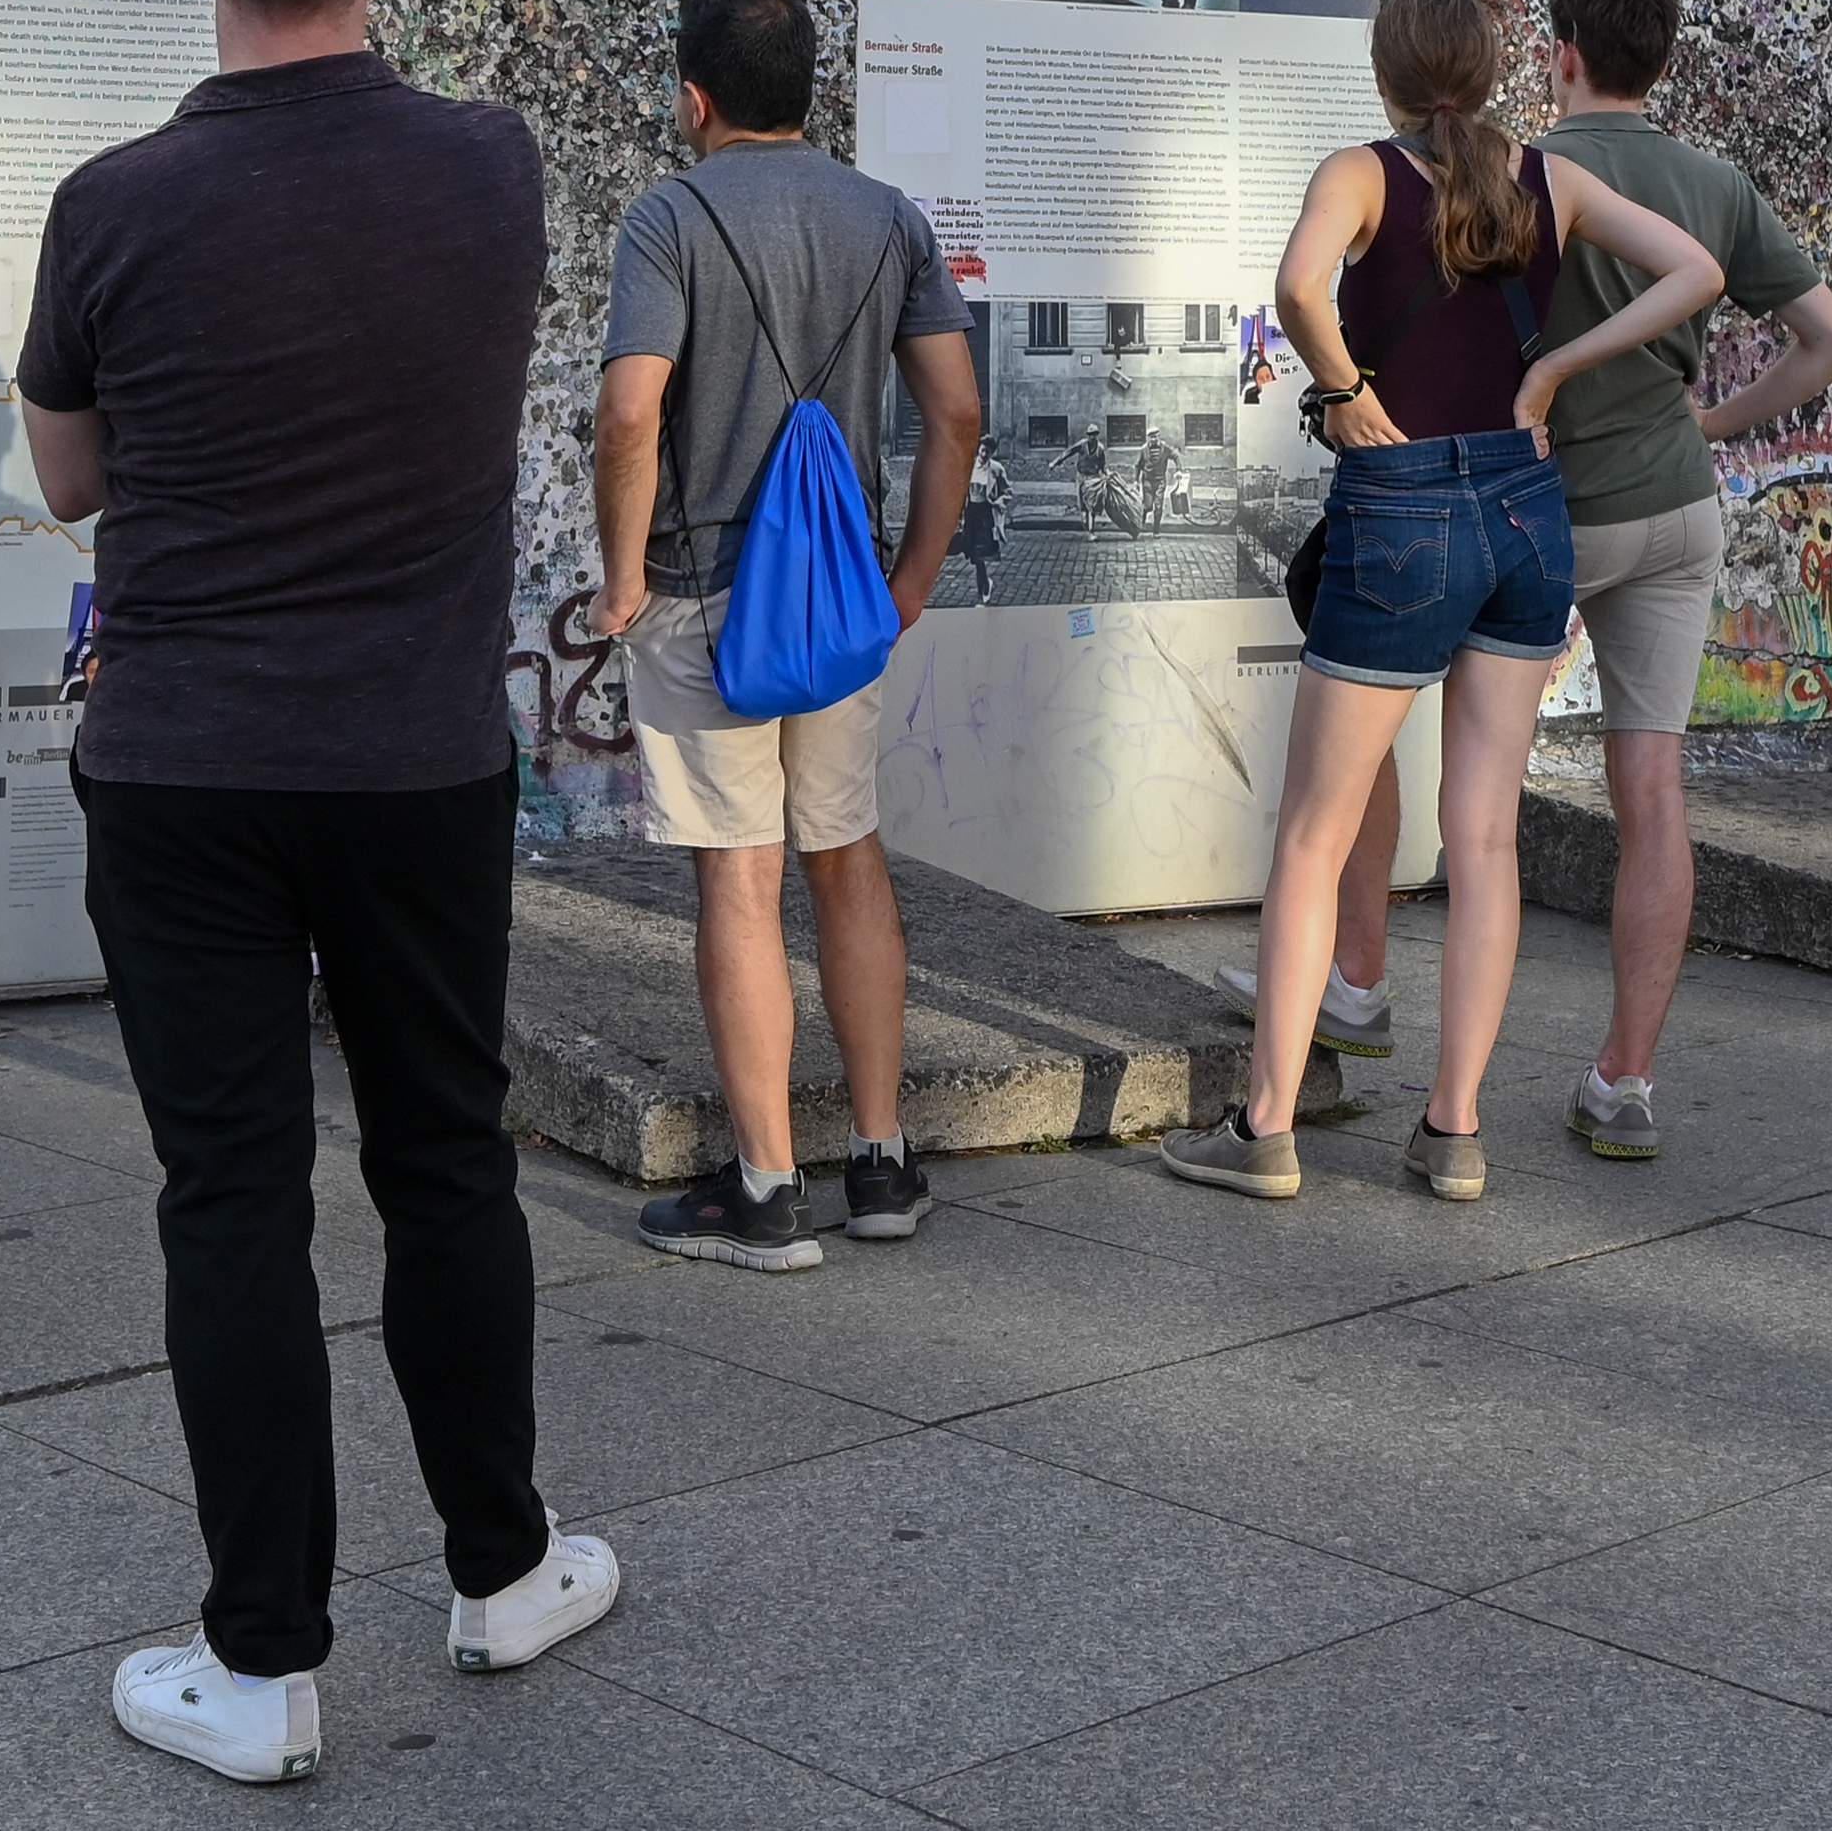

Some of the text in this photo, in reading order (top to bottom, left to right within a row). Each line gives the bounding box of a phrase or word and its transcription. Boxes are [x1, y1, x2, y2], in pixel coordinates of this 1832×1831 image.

[864, 40, 943, 53] Bernauer Straße
[864, 62, 942, 76] Bernauer Straße
[1237, 664, 1299, 677] BERLINE
[43, 750, 68, 760] Berlin
